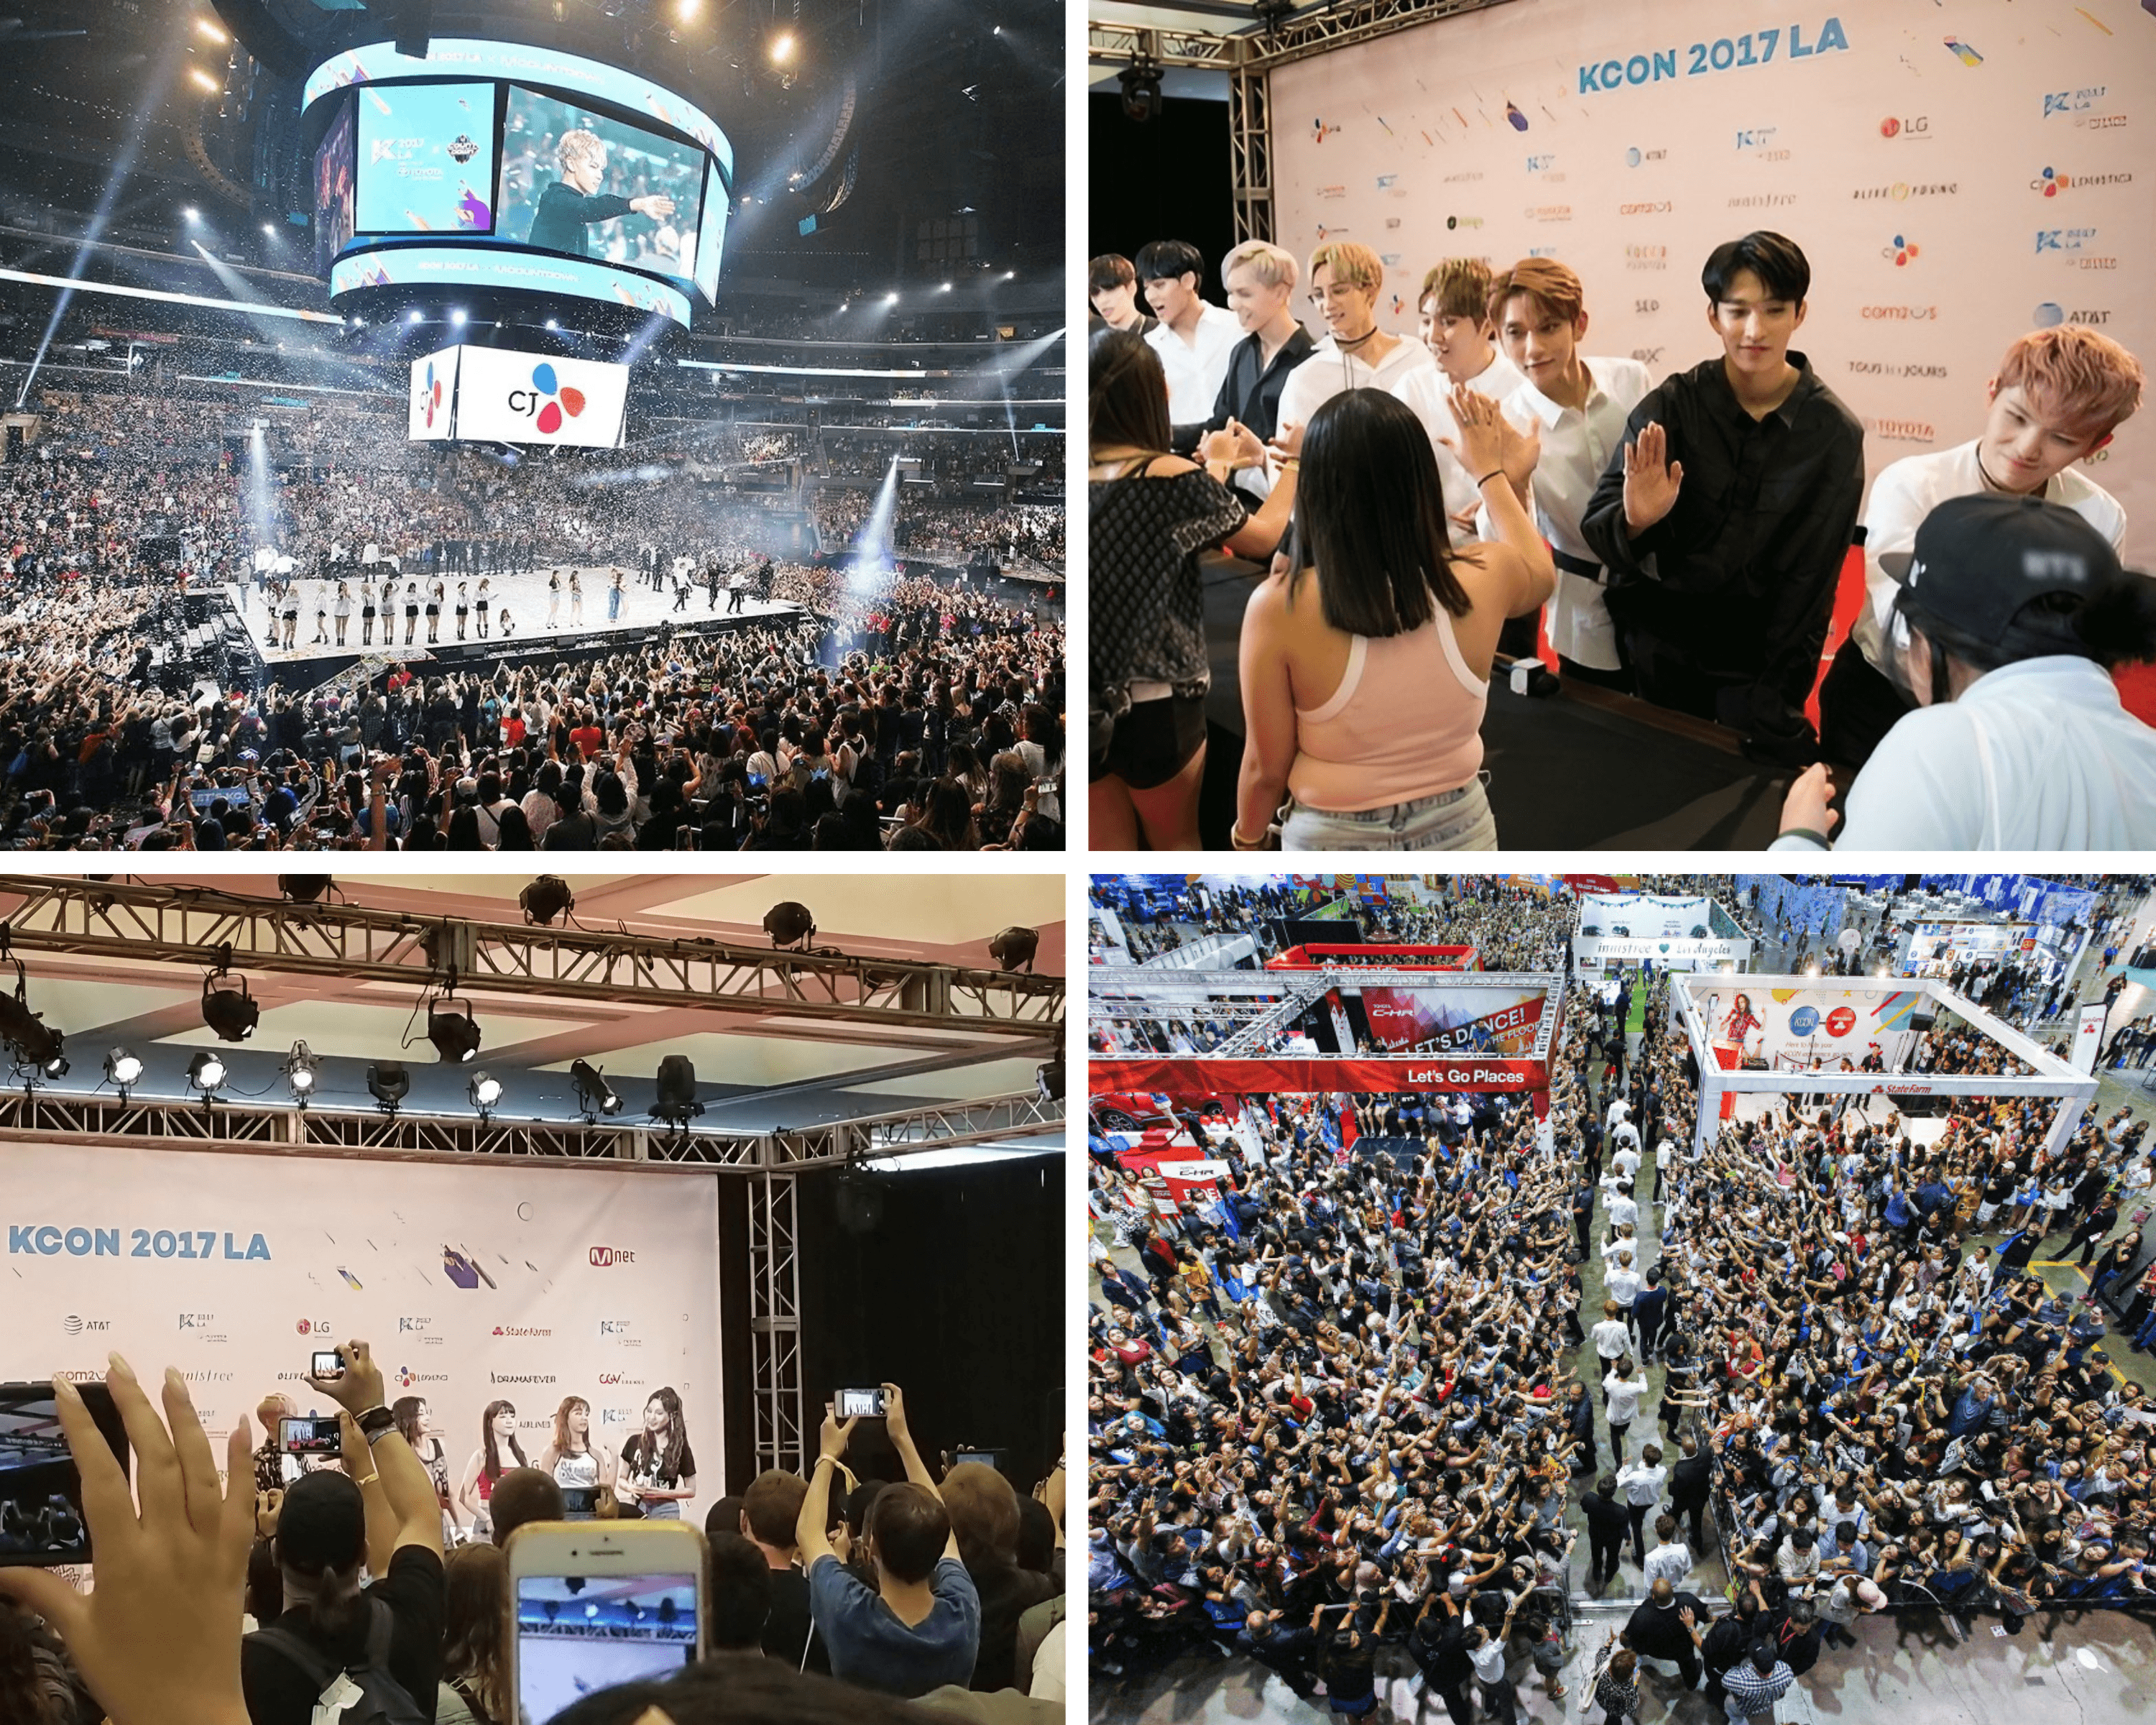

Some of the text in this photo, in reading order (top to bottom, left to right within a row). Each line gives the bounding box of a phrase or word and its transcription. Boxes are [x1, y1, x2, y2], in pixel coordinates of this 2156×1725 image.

[1579, 17, 1849, 93] KCON 2017 LA
[1905, 116, 1929, 134] LG
[508, 390, 539, 418] CJ
[1408, 1069, 1524, 1083] Let's Go Places
[9, 1225, 272, 1260] KCON 2017 LA
[589, 1246, 635, 1266] Mnet
[314, 1321, 330, 1333] LG
